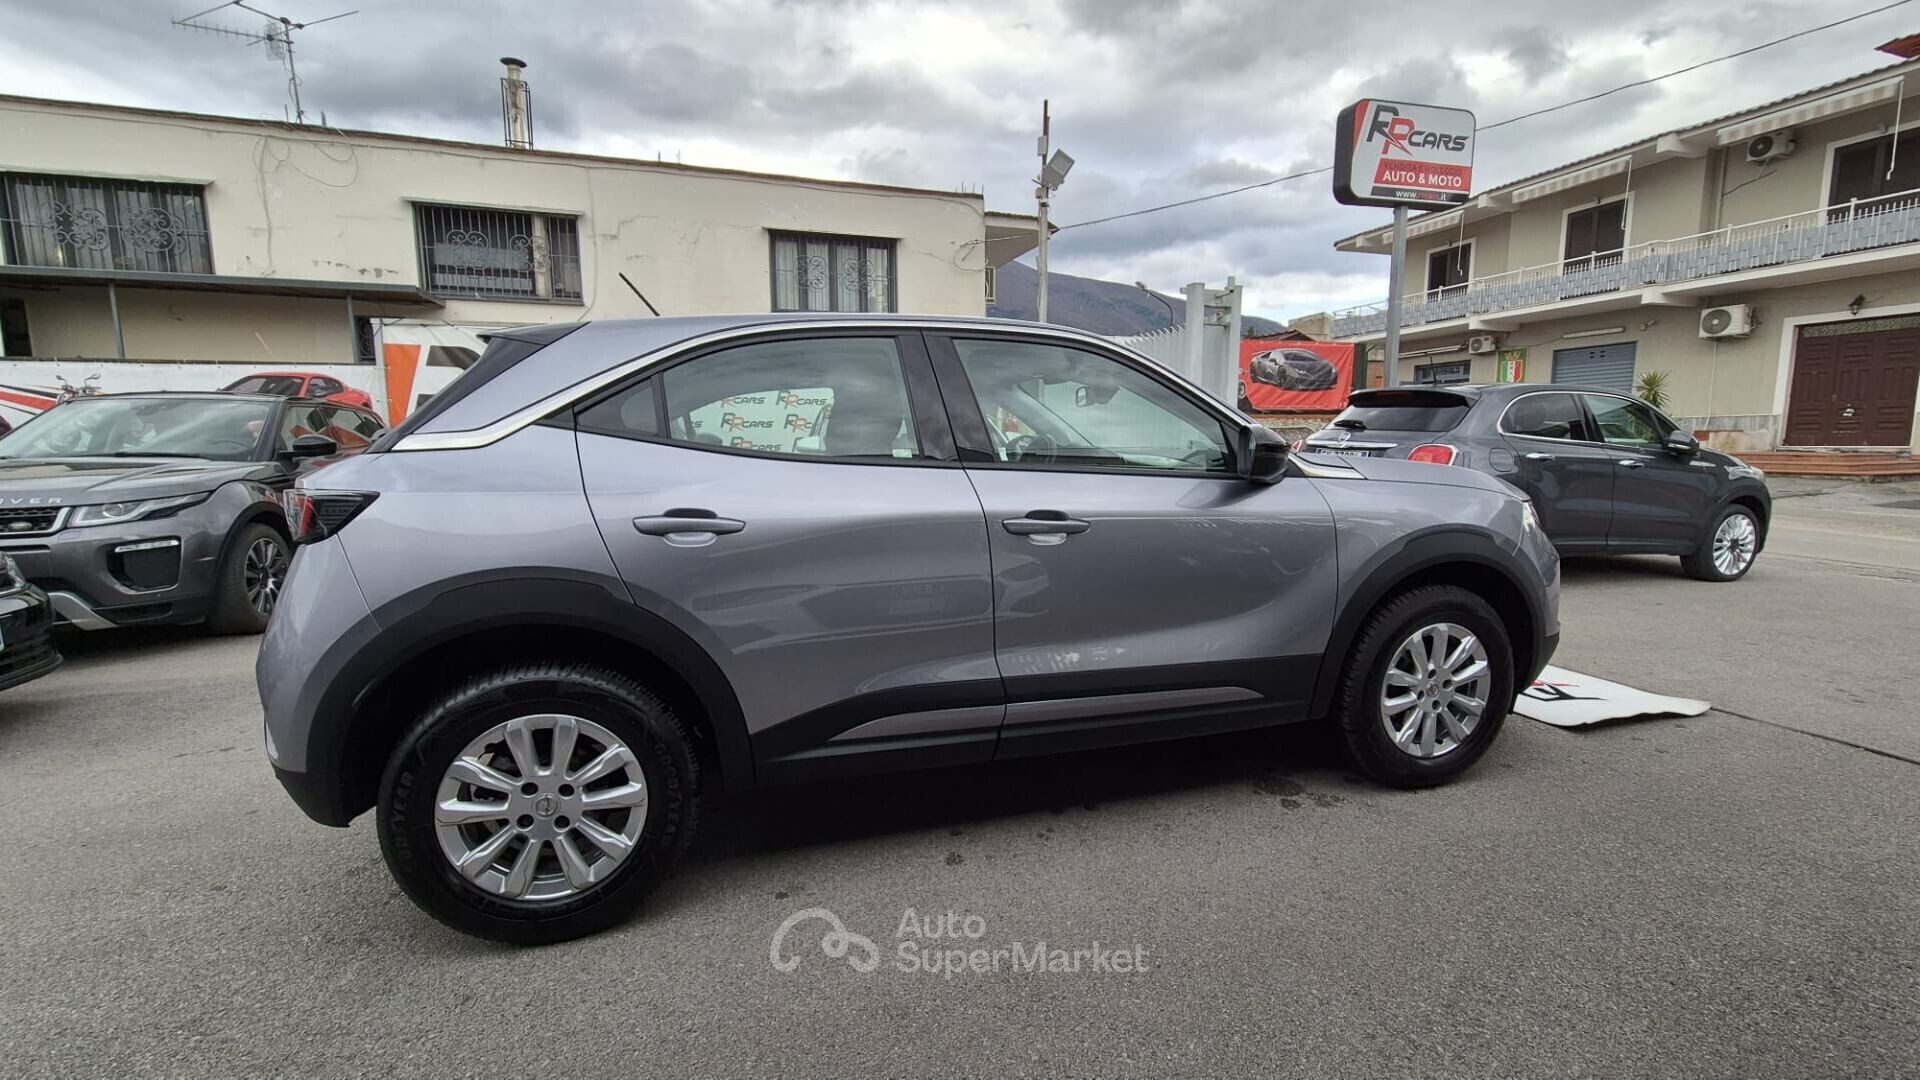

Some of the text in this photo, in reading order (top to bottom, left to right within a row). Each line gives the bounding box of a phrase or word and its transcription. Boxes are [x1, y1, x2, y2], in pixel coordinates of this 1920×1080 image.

[1382, 170, 1462, 187] AUTO & MOTO
